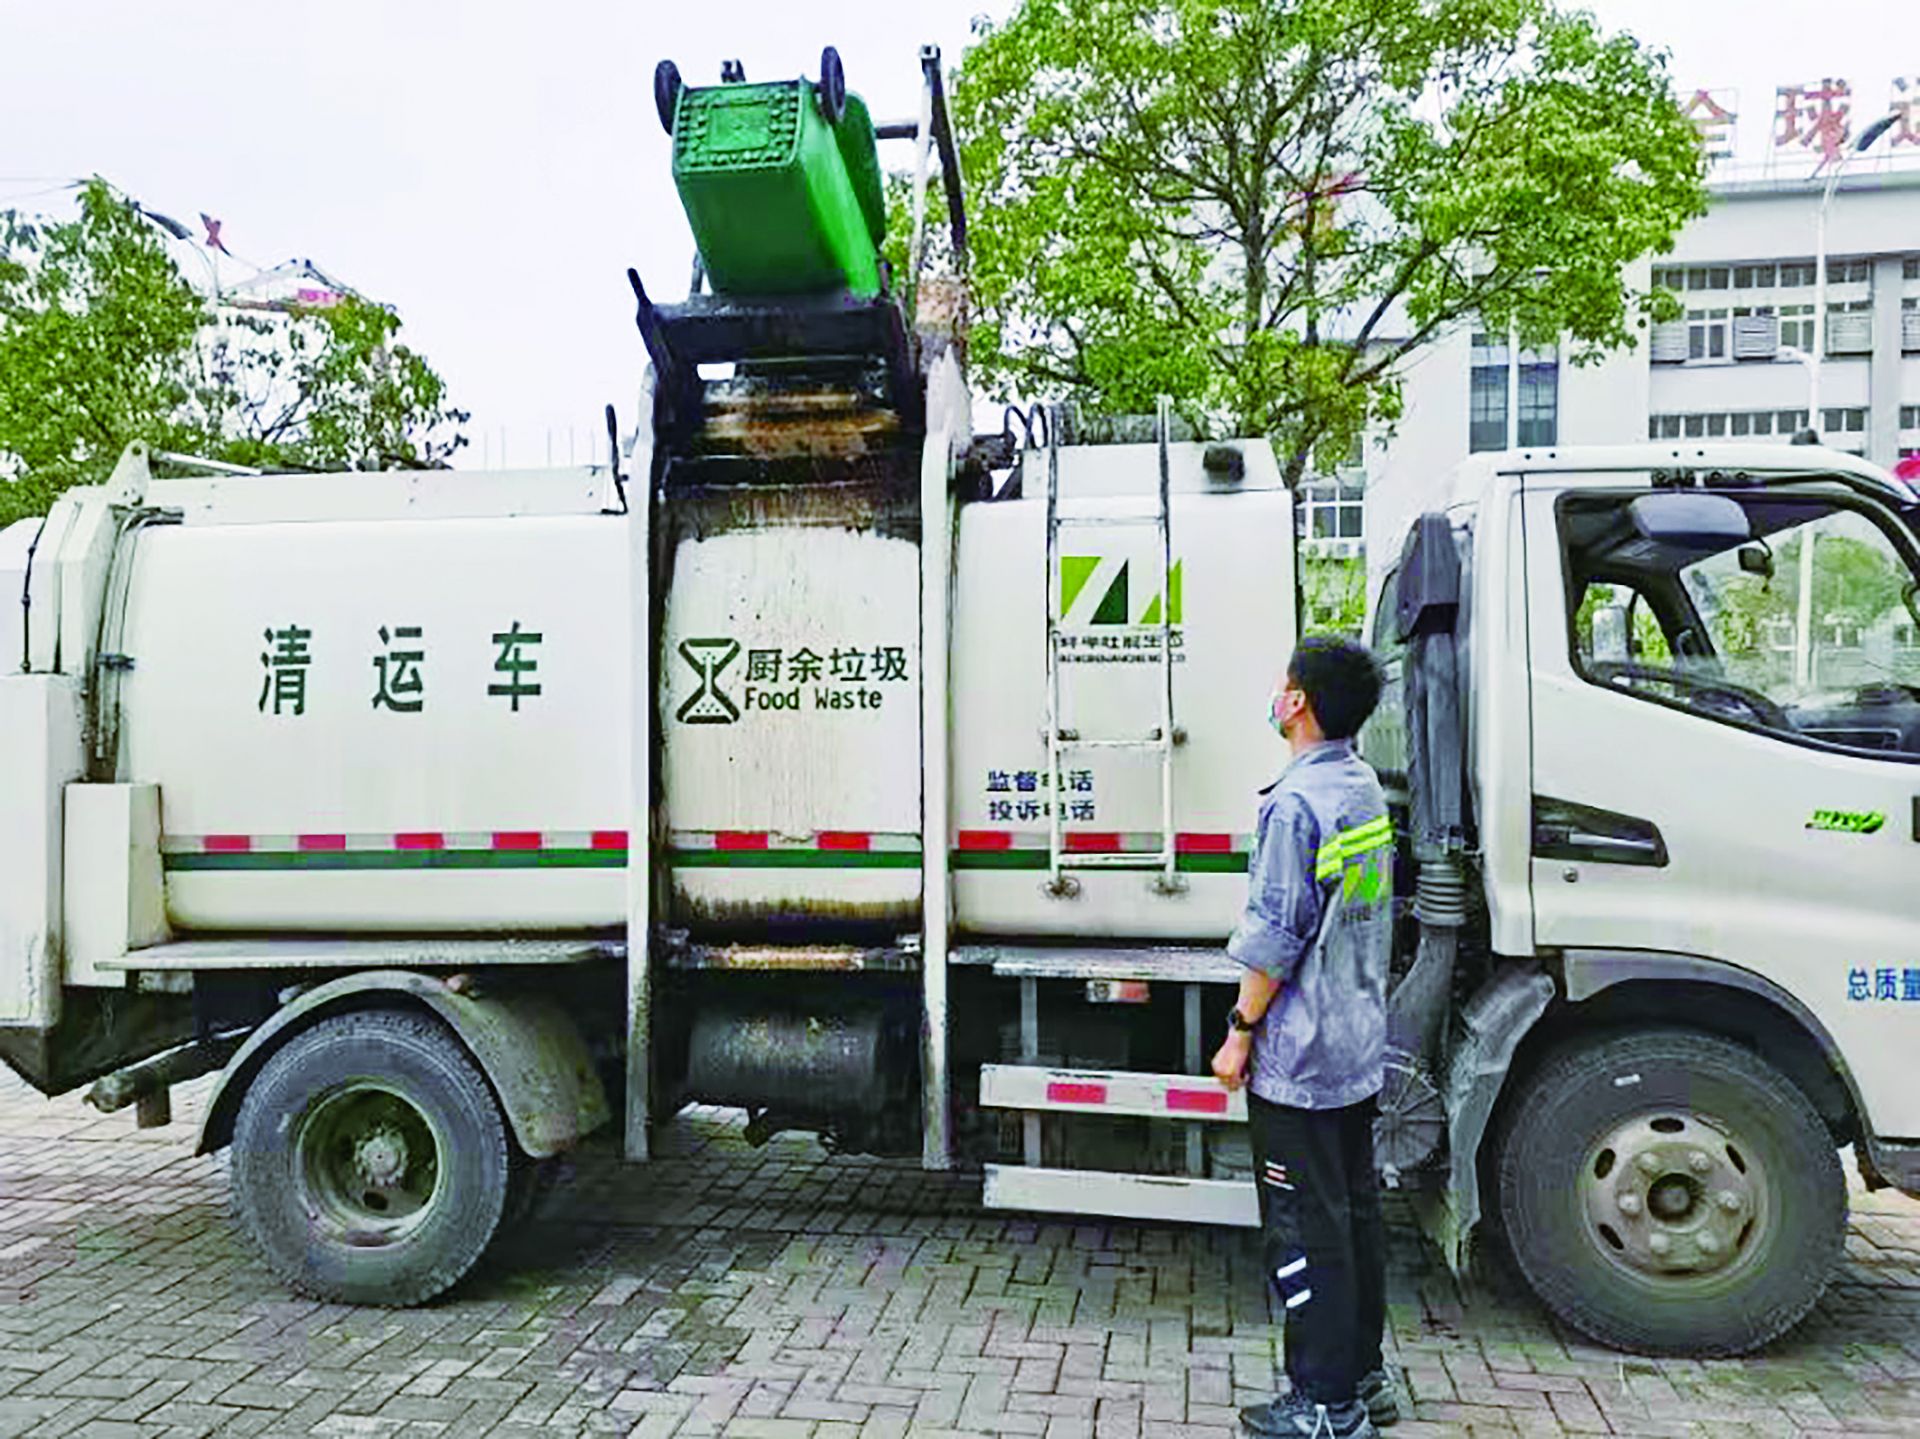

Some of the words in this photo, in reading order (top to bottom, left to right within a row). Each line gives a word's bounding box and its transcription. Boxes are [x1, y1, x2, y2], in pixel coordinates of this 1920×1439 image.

[258, 621, 543, 715] 清运车
[744, 646, 909, 684] 厨余垃圾
[744, 687, 800, 710] Food
[815, 687, 883, 709] Waste
[986, 770, 1093, 792] 监督电话
[989, 800, 1095, 821] 投诉电话
[1847, 968, 1920, 1001] 总质量
